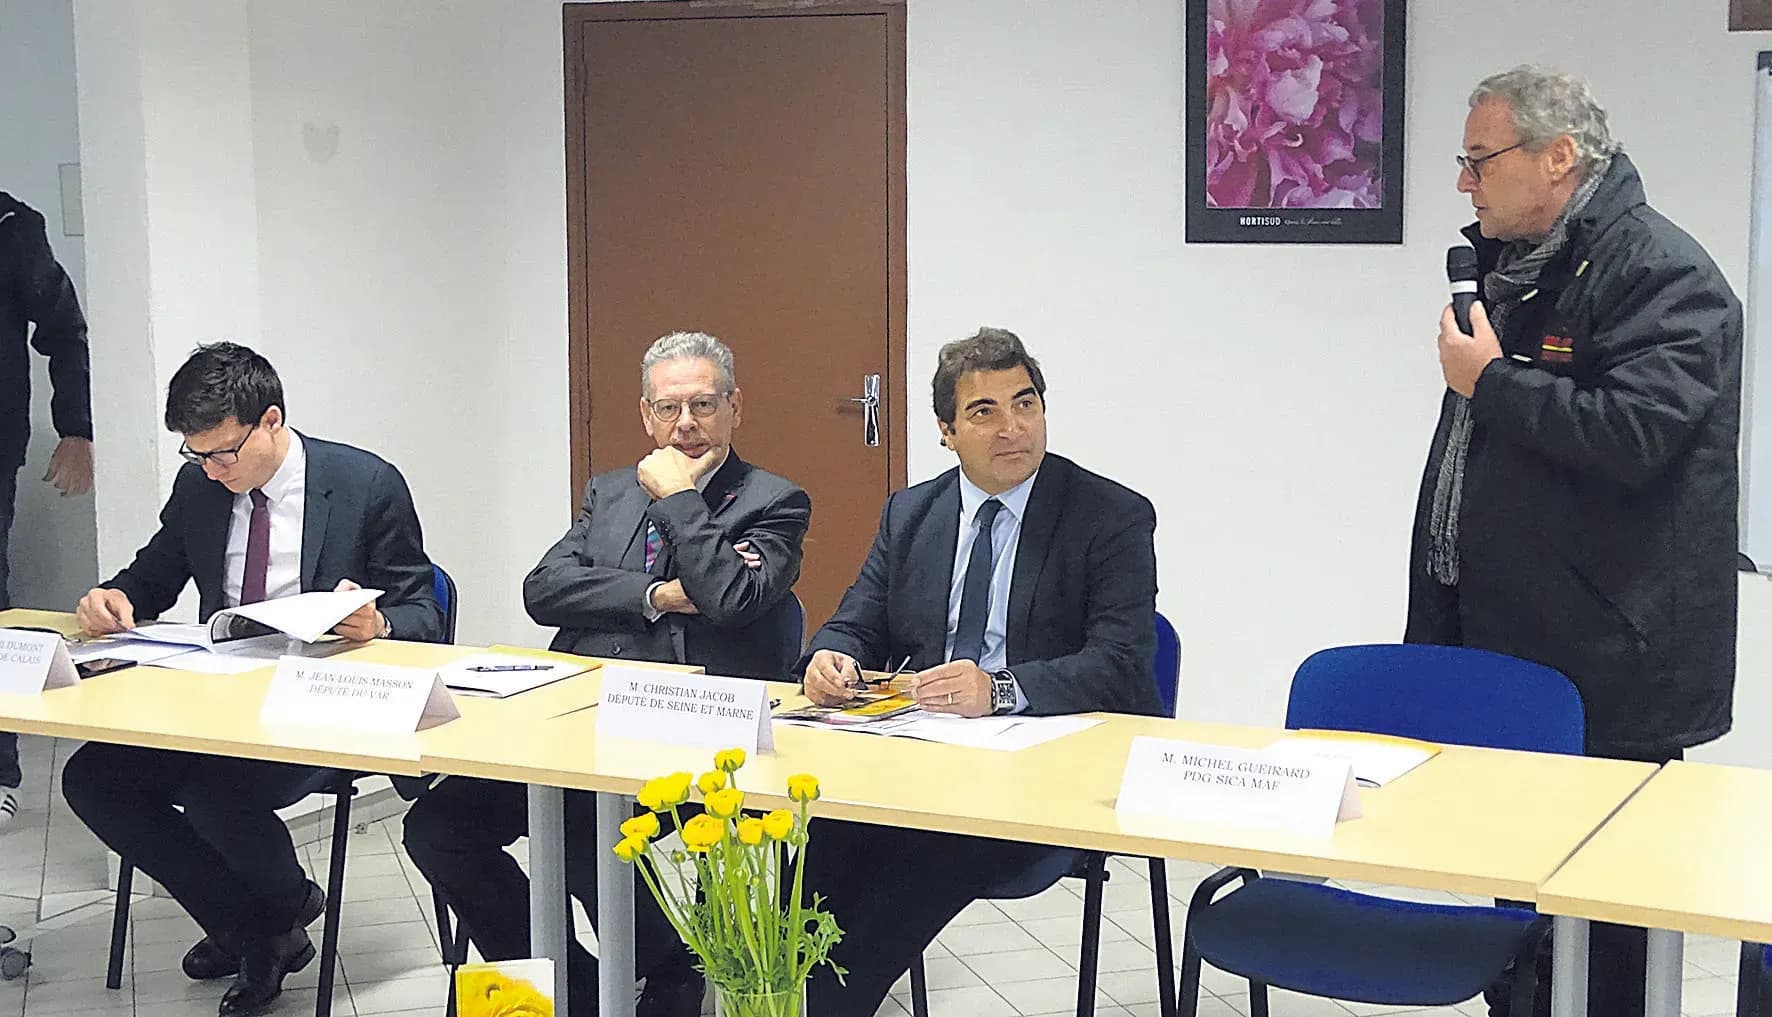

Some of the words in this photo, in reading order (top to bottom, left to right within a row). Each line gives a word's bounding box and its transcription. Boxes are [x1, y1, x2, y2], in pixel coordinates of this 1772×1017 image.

[1240, 216, 1281, 226] HORTISUD
[372, 677, 414, 689] MASSON
[370, 689, 391, 700] VAR
[643, 683, 698, 699] CHRISTIAN
[699, 689, 735, 703] JACOB
[650, 698, 665, 709] DE
[667, 700, 698, 713] SEINE
[700, 703, 714, 715] ET
[716, 705, 754, 720] MARNE
[1182, 755, 1234, 771] MICHEL
[1238, 761, 1311, 779] GUEIRARD
[1183, 770, 1212, 783] PDG
[1215, 775, 1246, 788] SICA
